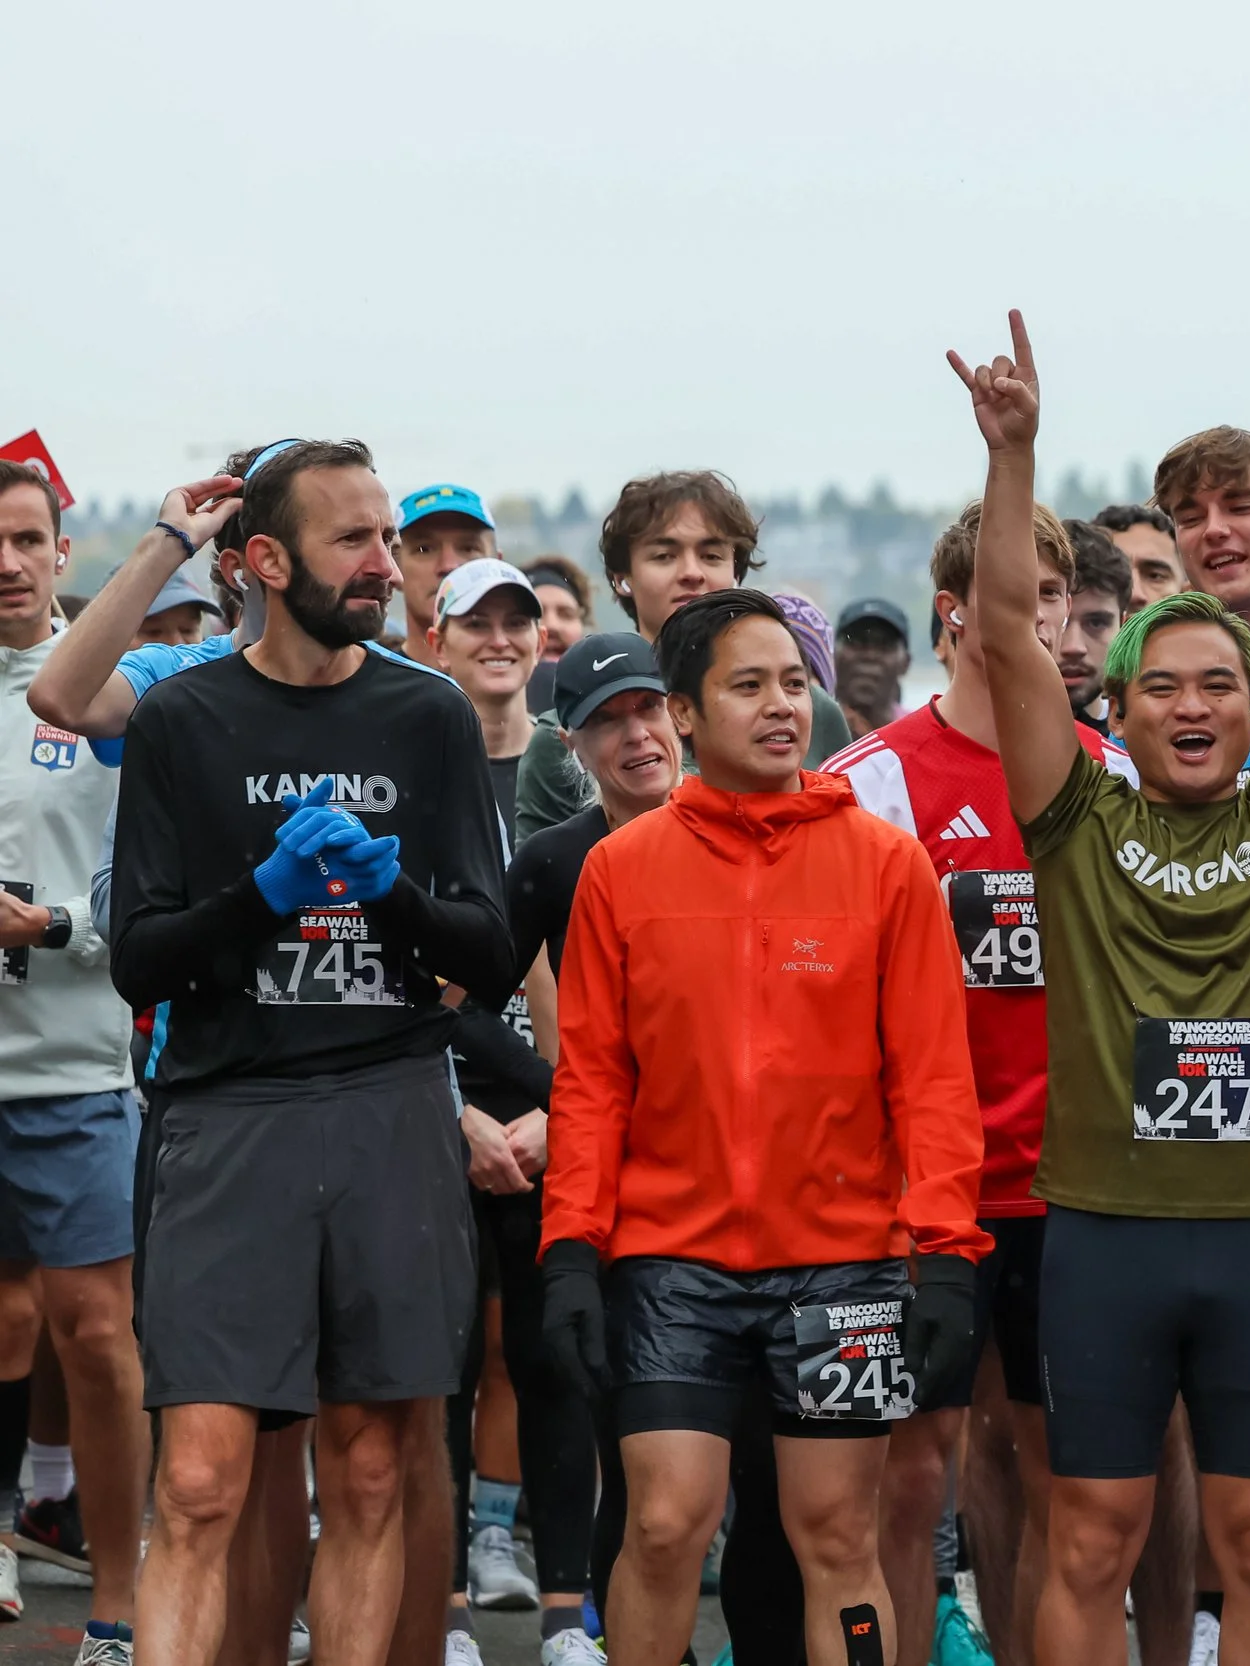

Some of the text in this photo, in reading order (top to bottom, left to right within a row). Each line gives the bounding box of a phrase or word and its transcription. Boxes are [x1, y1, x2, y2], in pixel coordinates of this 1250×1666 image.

[36, 731, 77, 743] LYONNAIS
[982, 873, 1034, 885] VANCO
[984, 885, 1034, 896] IS AWES
[992, 903, 1036, 914] SEAW
[300, 917, 368, 928] SEAWALL
[993, 912, 1021, 925] 10K
[301, 928, 368, 940] 10K RACE
[278, 943, 384, 993] 745
[1168, 1021, 1250, 1034] VANCOUVER
[1169, 1033, 1250, 1044] IS AWESOME
[1177, 1053, 1245, 1065] SEAWALL
[1178, 1063, 1245, 1077] 10K RACE
[828, 1312, 903, 1330] IS AWESOME
[839, 1332, 900, 1348] SEAWALL
[867, 1344, 901, 1358] RACE
[819, 1357, 916, 1411] 245
